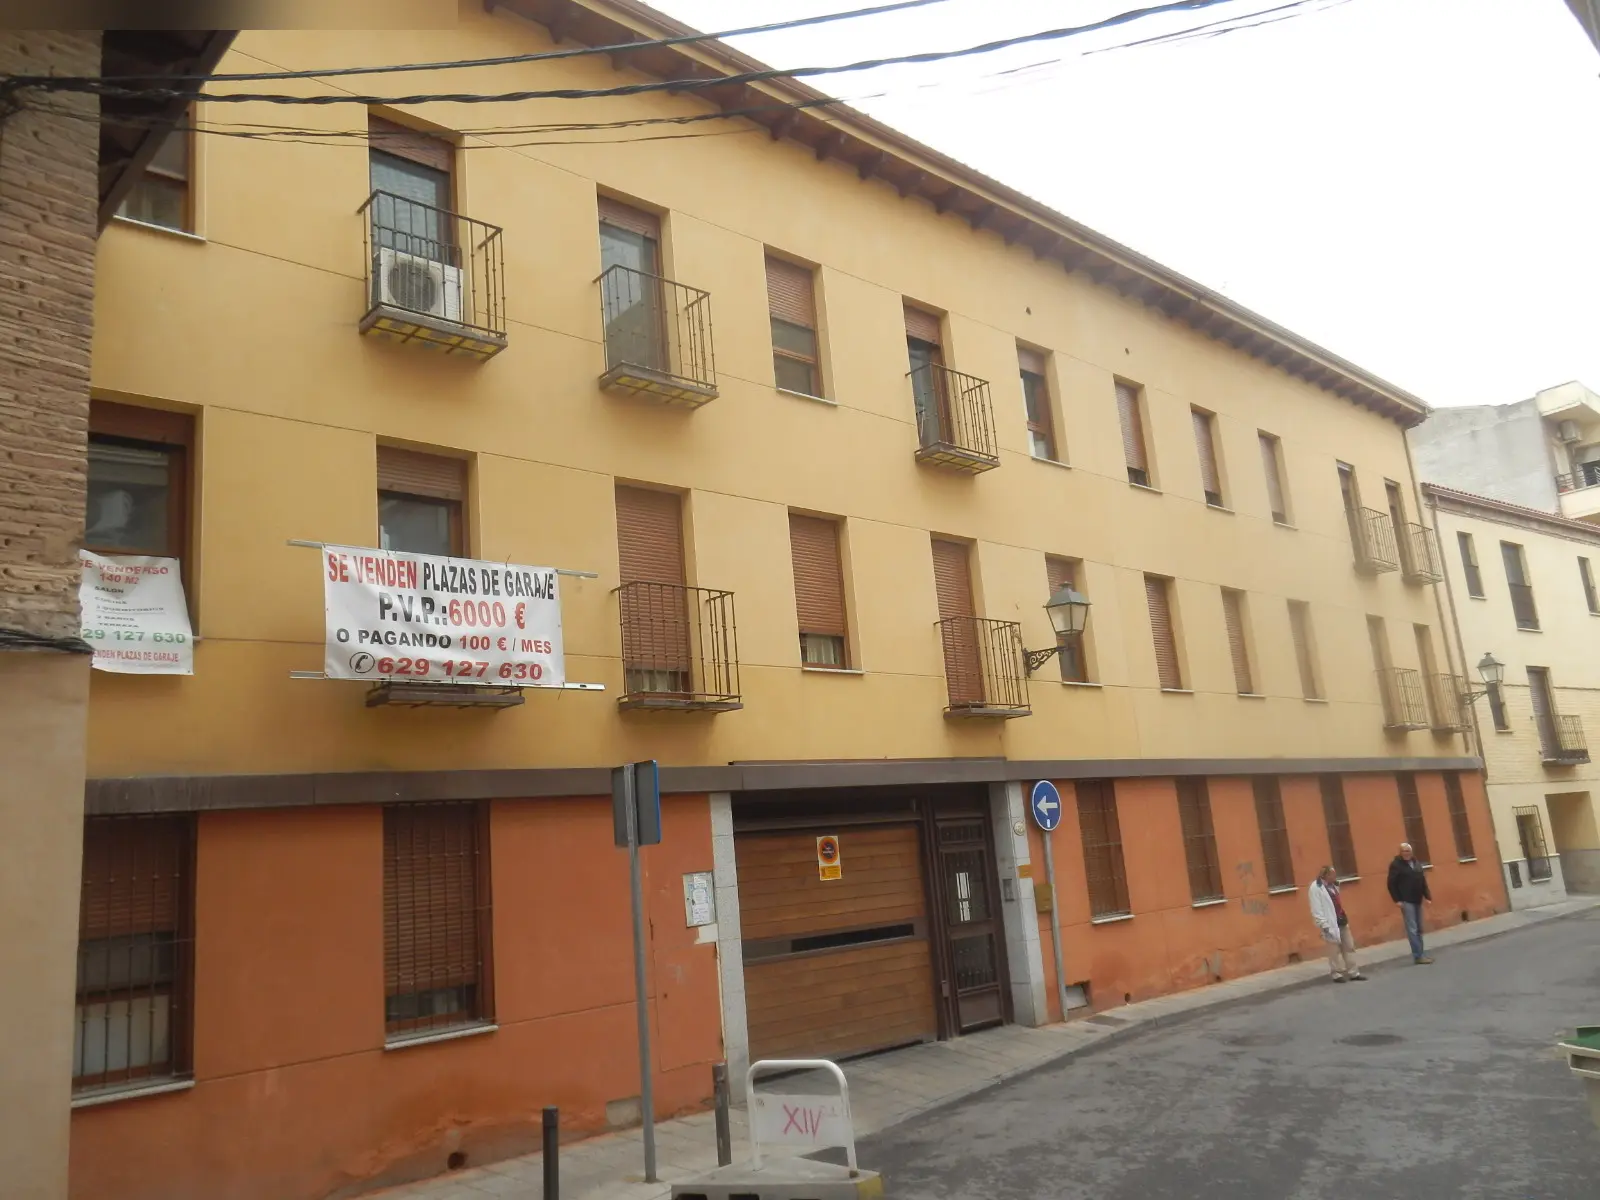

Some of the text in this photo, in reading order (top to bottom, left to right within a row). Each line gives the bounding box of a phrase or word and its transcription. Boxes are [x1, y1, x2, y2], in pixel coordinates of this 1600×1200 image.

[328, 555, 555, 600] SE VENDEN PLAZAS DE GARAJE
[514, 602, 526, 630] €
[82, 628, 186, 643] 29 127 630
[336, 628, 350, 643] O
[358, 629, 452, 649] PAGANDO
[459, 635, 491, 650] 100
[496, 637, 507, 652] €
[521, 640, 552, 655] MES
[117, 650, 142, 660] PLAZAS
[143, 652, 152, 660] DE
[153, 652, 179, 662] GARAJE
[377, 657, 543, 681] 629 127 630
[783, 1103, 822, 1138] XIV
